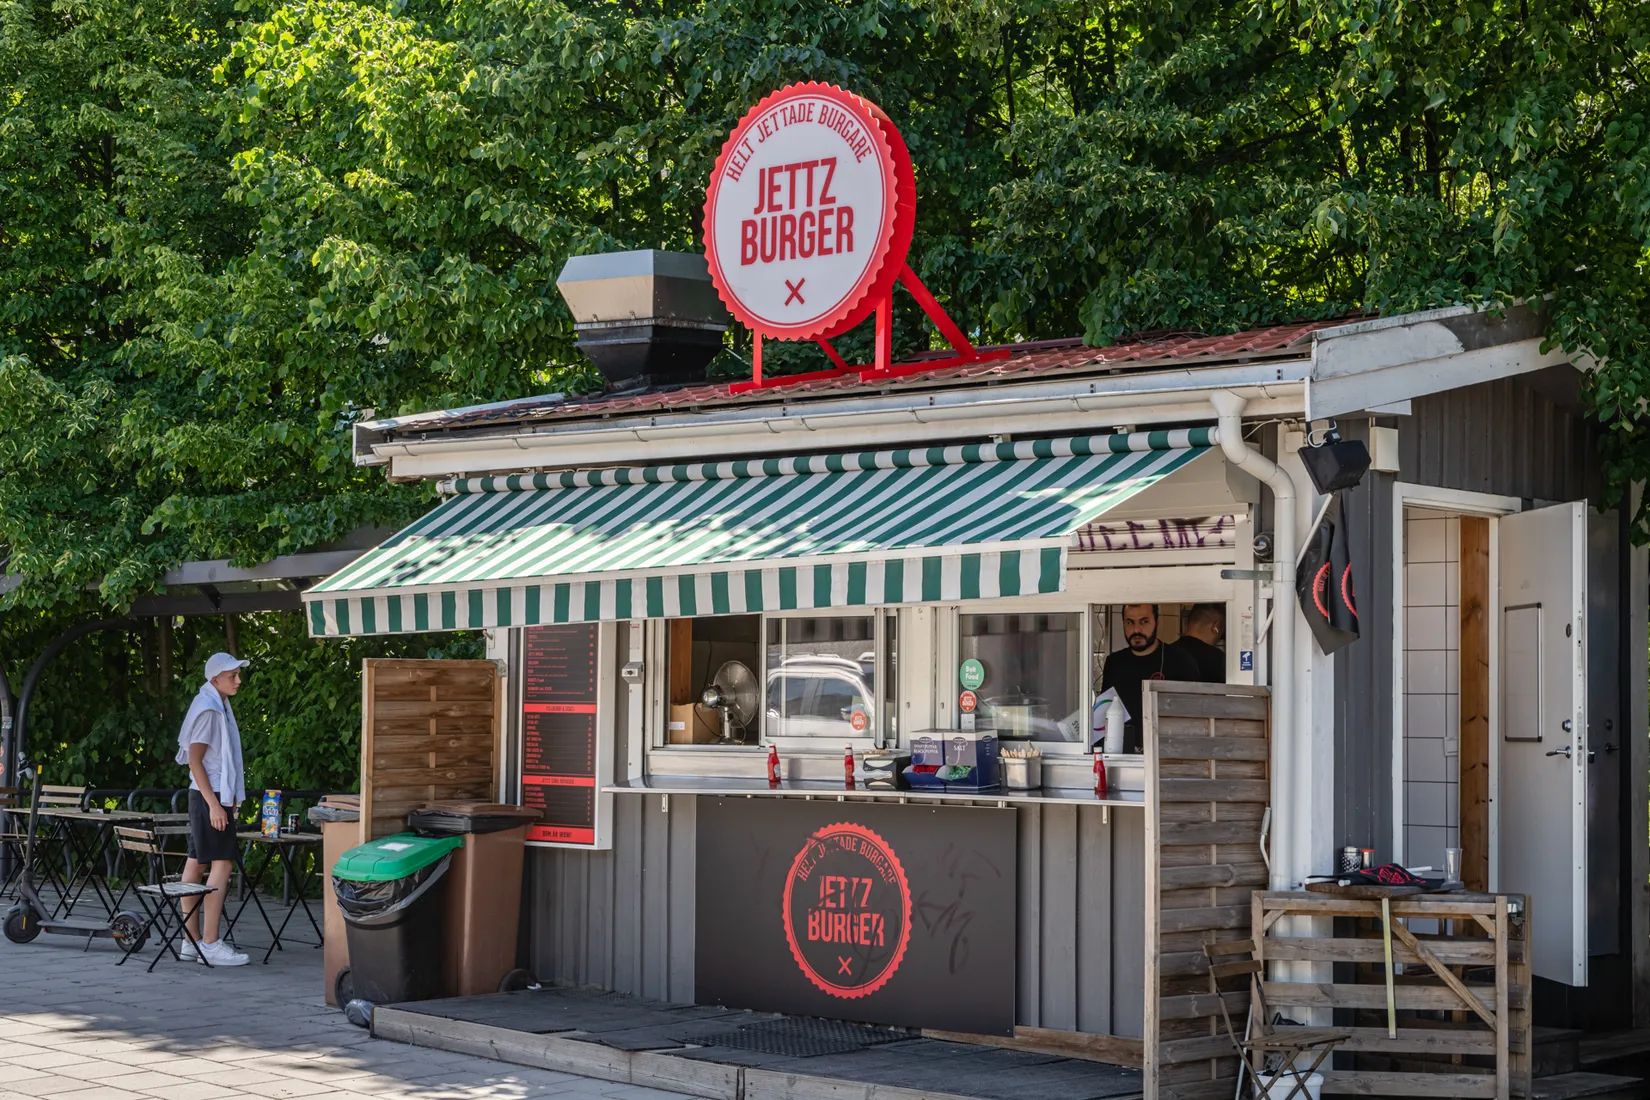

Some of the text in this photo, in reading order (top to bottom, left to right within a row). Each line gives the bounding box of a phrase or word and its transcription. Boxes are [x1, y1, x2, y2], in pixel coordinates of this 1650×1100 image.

[726, 102, 873, 183] HELT JETTADE BURGARE
[753, 157, 837, 215] JETTZ
[741, 205, 854, 266] BURGER
[808, 908, 885, 947] BURGER
